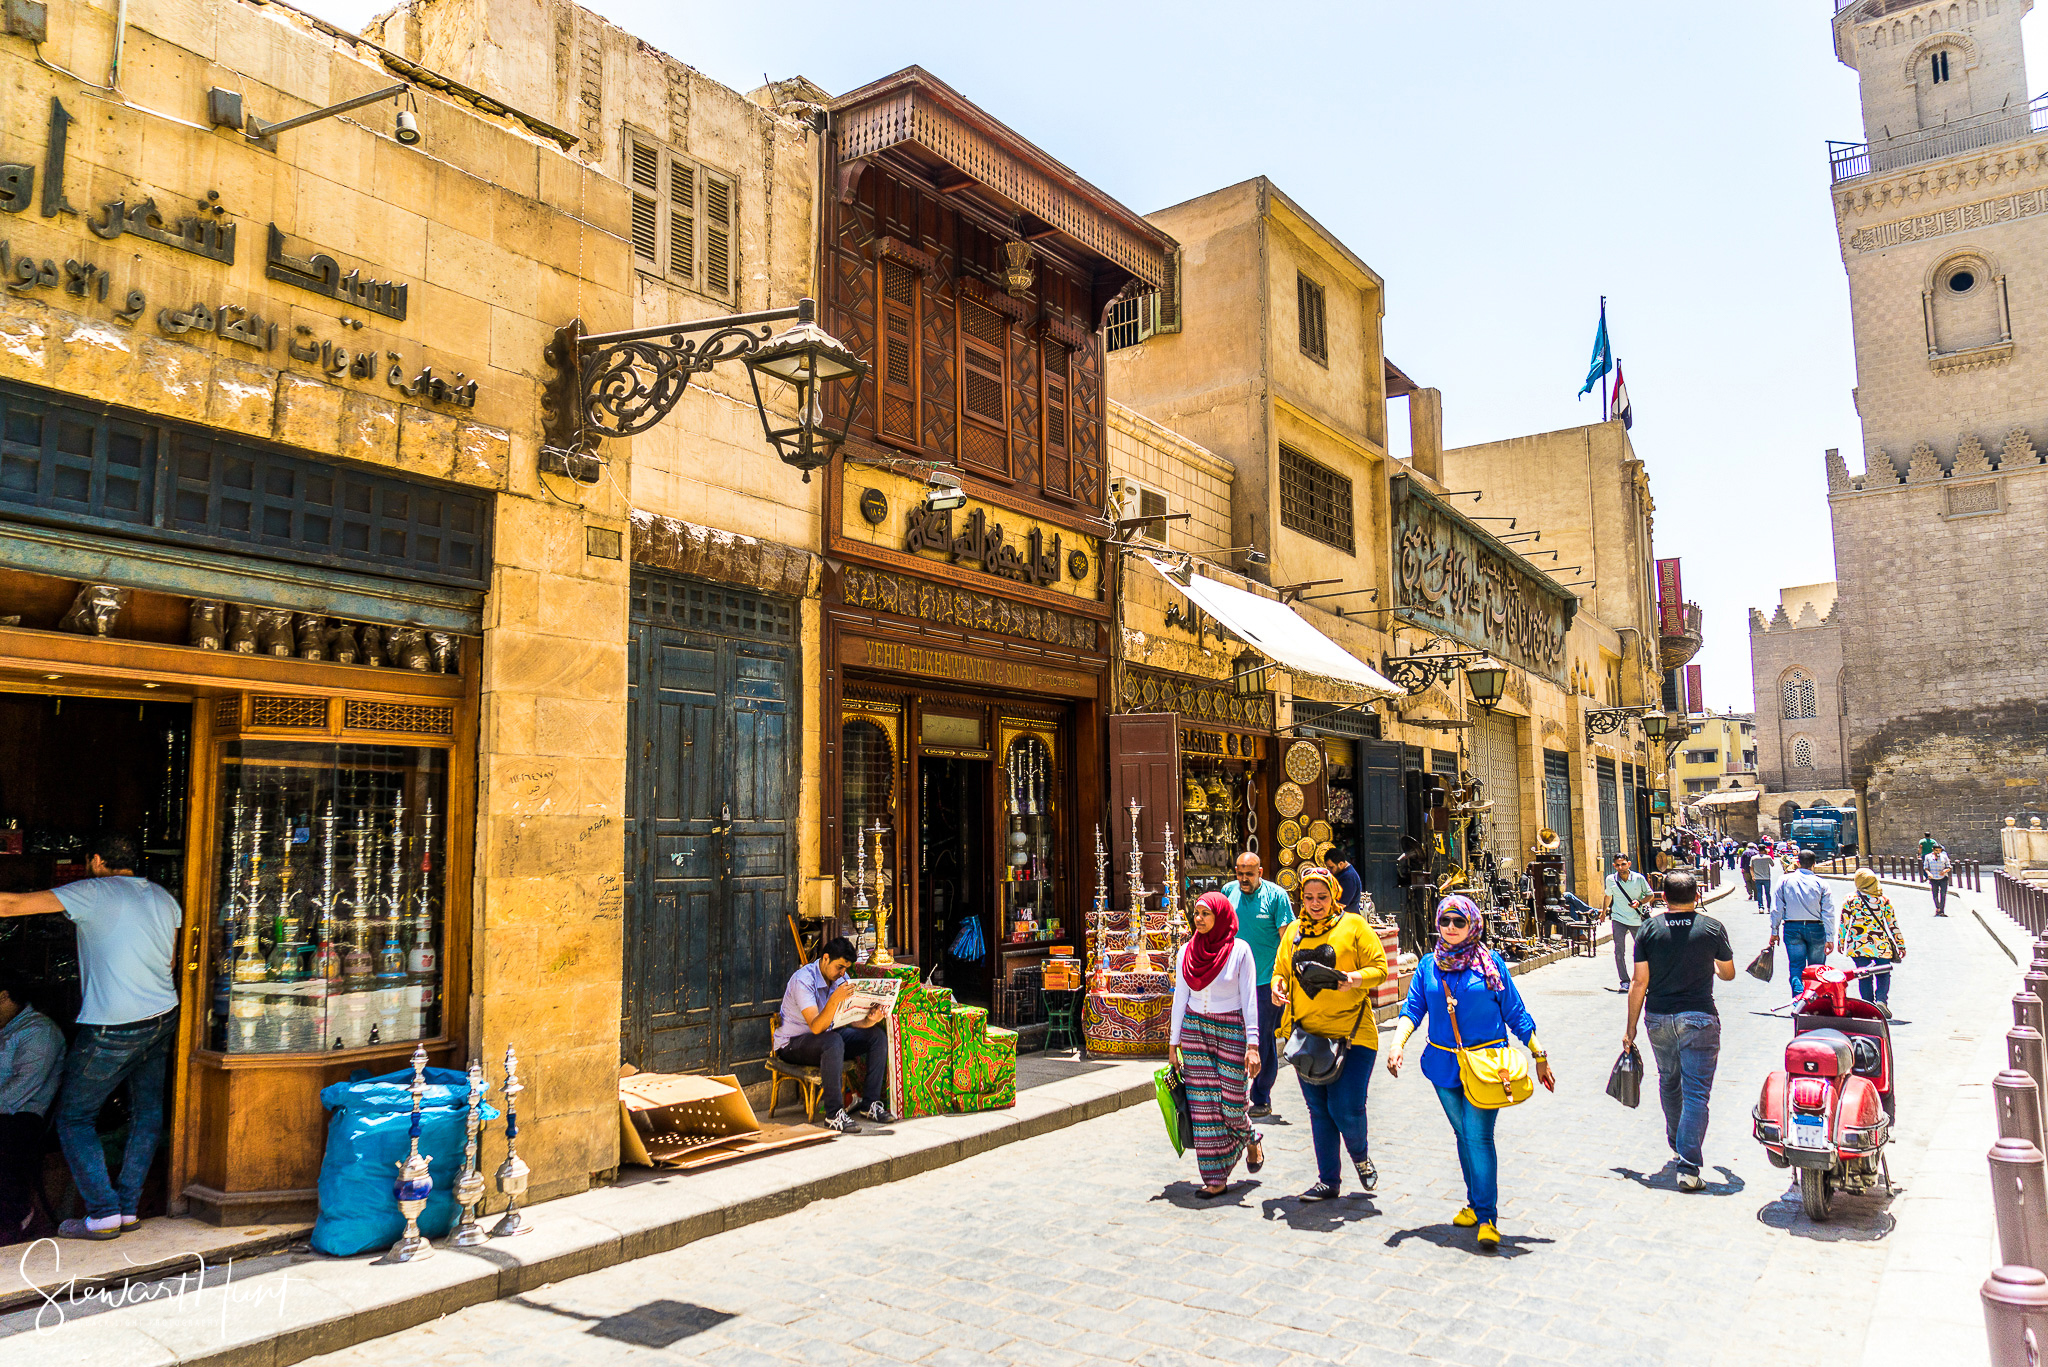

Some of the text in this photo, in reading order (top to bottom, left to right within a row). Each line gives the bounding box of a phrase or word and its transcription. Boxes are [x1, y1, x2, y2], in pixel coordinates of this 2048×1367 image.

[1661, 562, 1675, 587] Museum
[1662, 588, 1676, 607] Textile
[866, 641, 906, 670] YEHIA
[910, 648, 992, 682] ELKHAWANKY
[995, 662, 1003, 684] &
[1006, 663, 1033, 687] SONS
[1179, 730, 1223, 753] ELCOME
